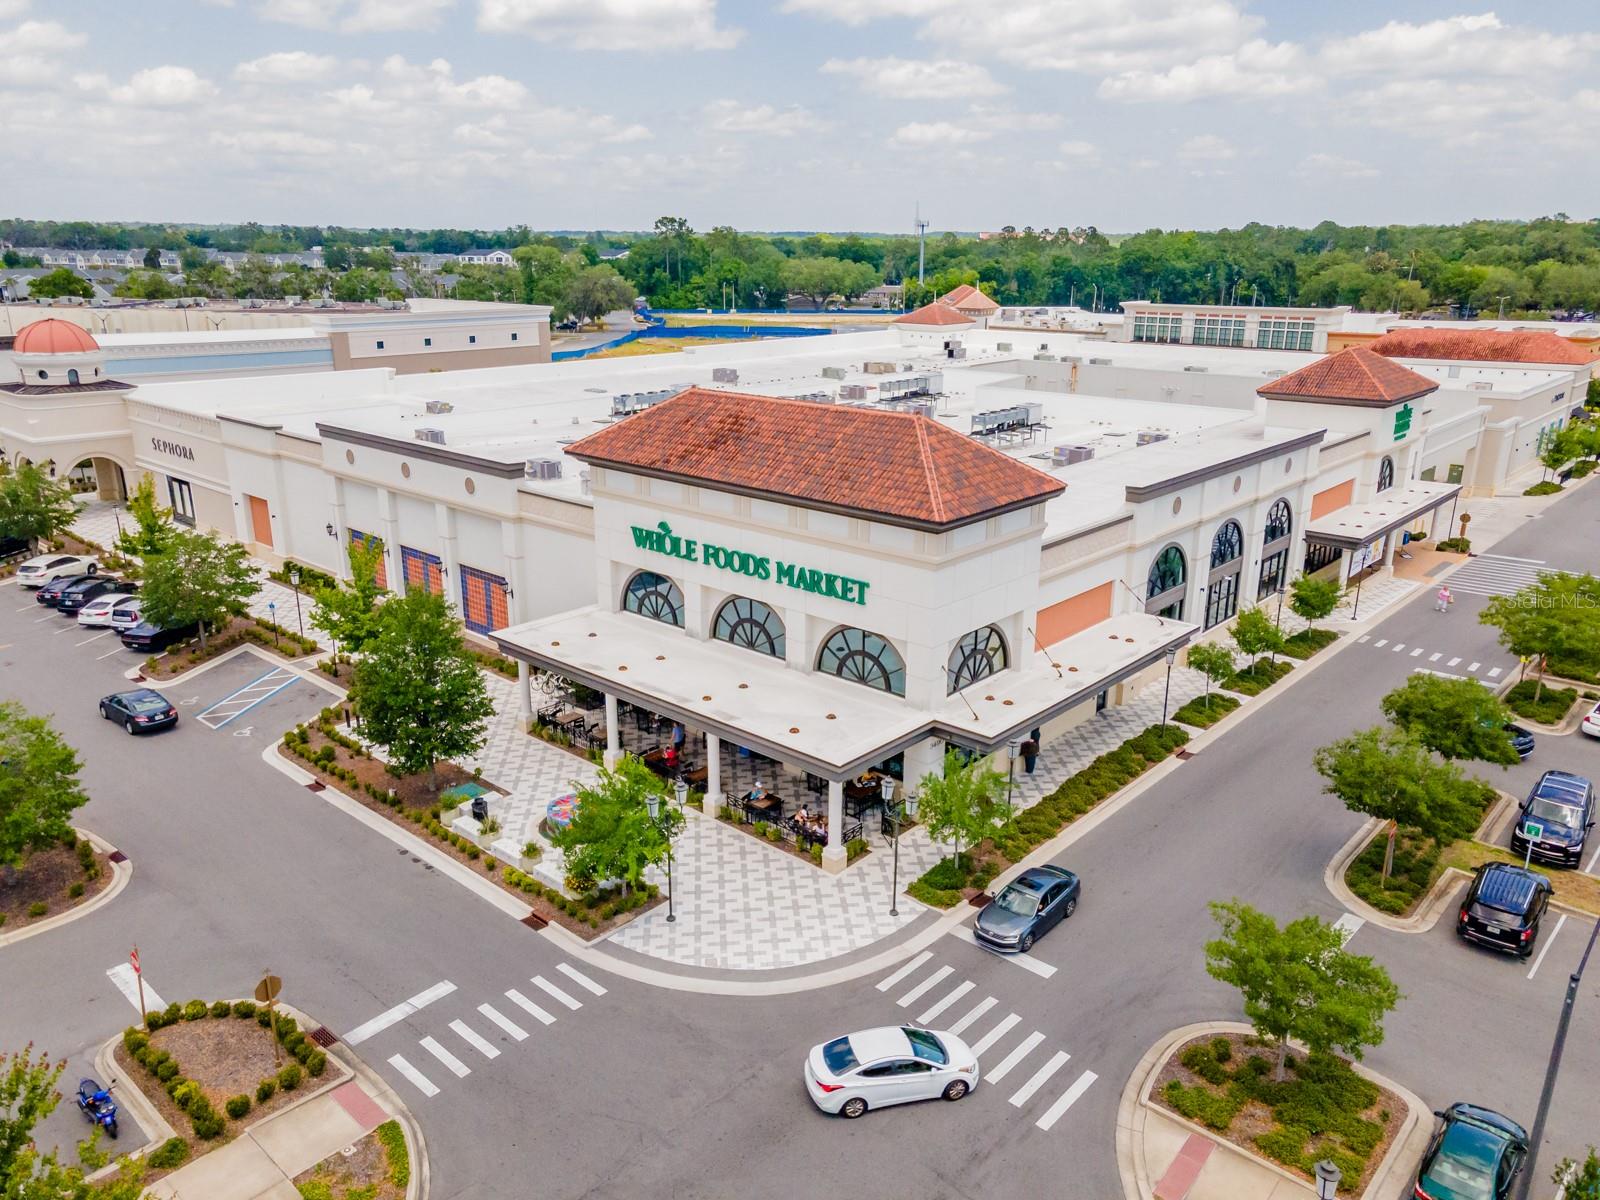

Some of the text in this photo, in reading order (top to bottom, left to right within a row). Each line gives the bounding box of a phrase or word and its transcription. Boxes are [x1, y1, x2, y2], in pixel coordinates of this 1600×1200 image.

[151, 437, 195, 461] SEPHORA
[630, 522, 870, 605] WHOLE FOODS MARKET
